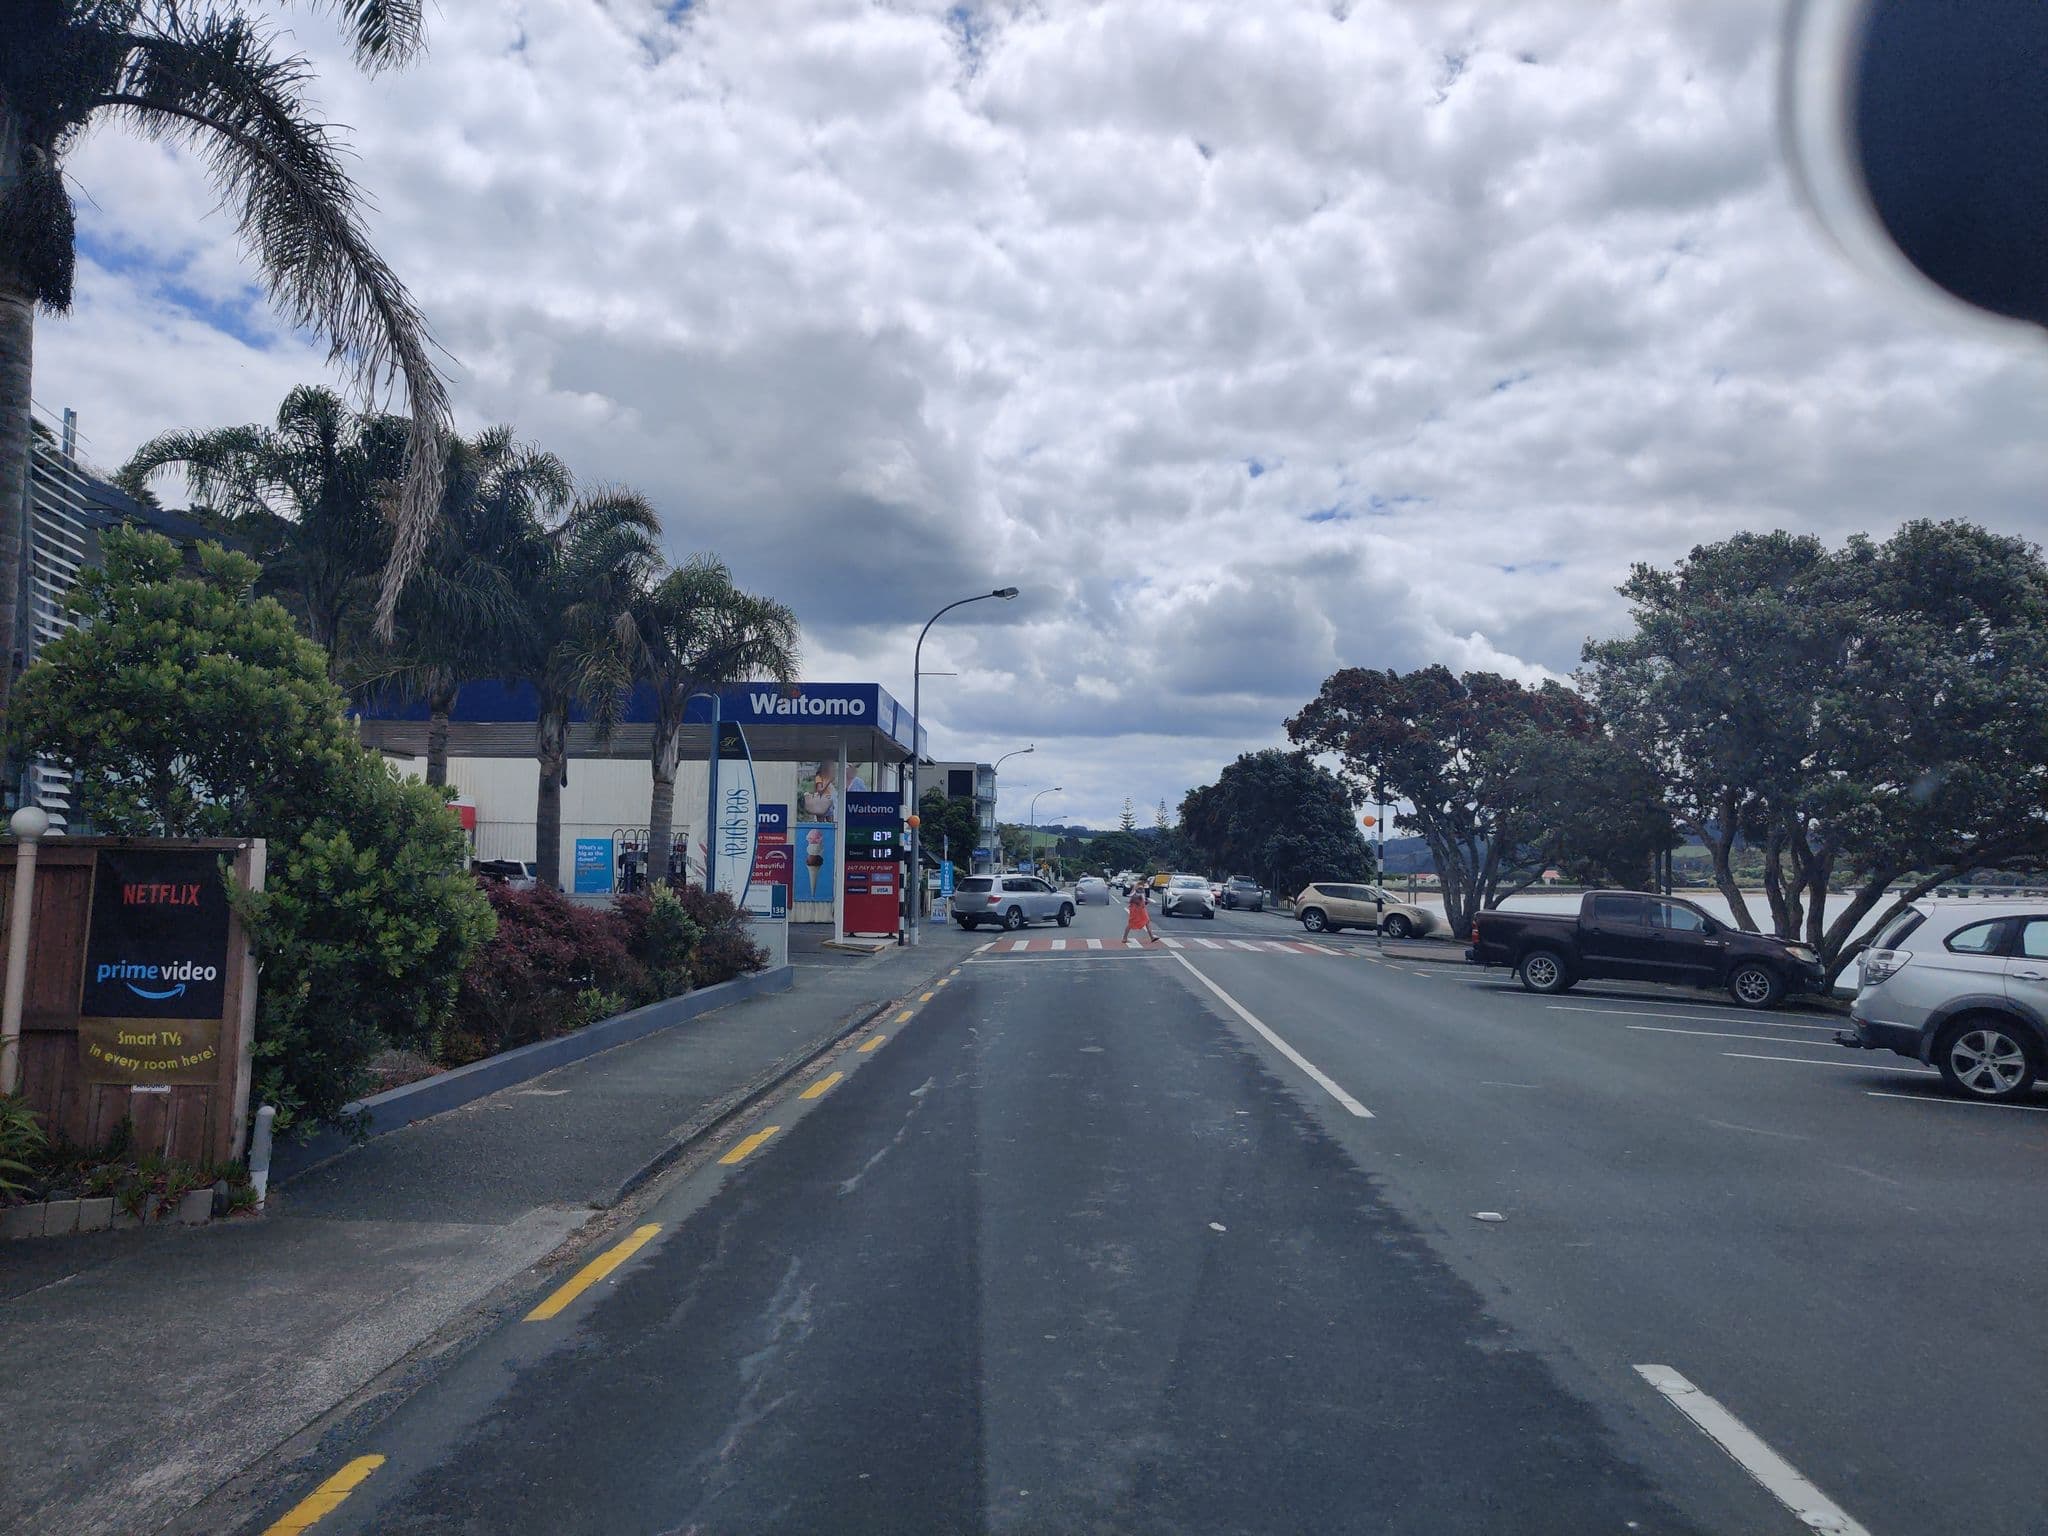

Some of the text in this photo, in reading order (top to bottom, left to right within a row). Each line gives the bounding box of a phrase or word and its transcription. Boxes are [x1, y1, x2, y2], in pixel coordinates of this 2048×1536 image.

[750, 693, 866, 716] Waitomo
[847, 804, 894, 814] Waitomo
[718, 788, 750, 861] sea spray
[123, 883, 200, 906] NETFLIX
[772, 906, 785, 914] 138
[96, 959, 217, 983] prime video
[118, 1031, 182, 1046] Smart TVs
[104, 1052, 141, 1071] every
[144, 1058, 178, 1070] room
[181, 1045, 217, 1067] here!
